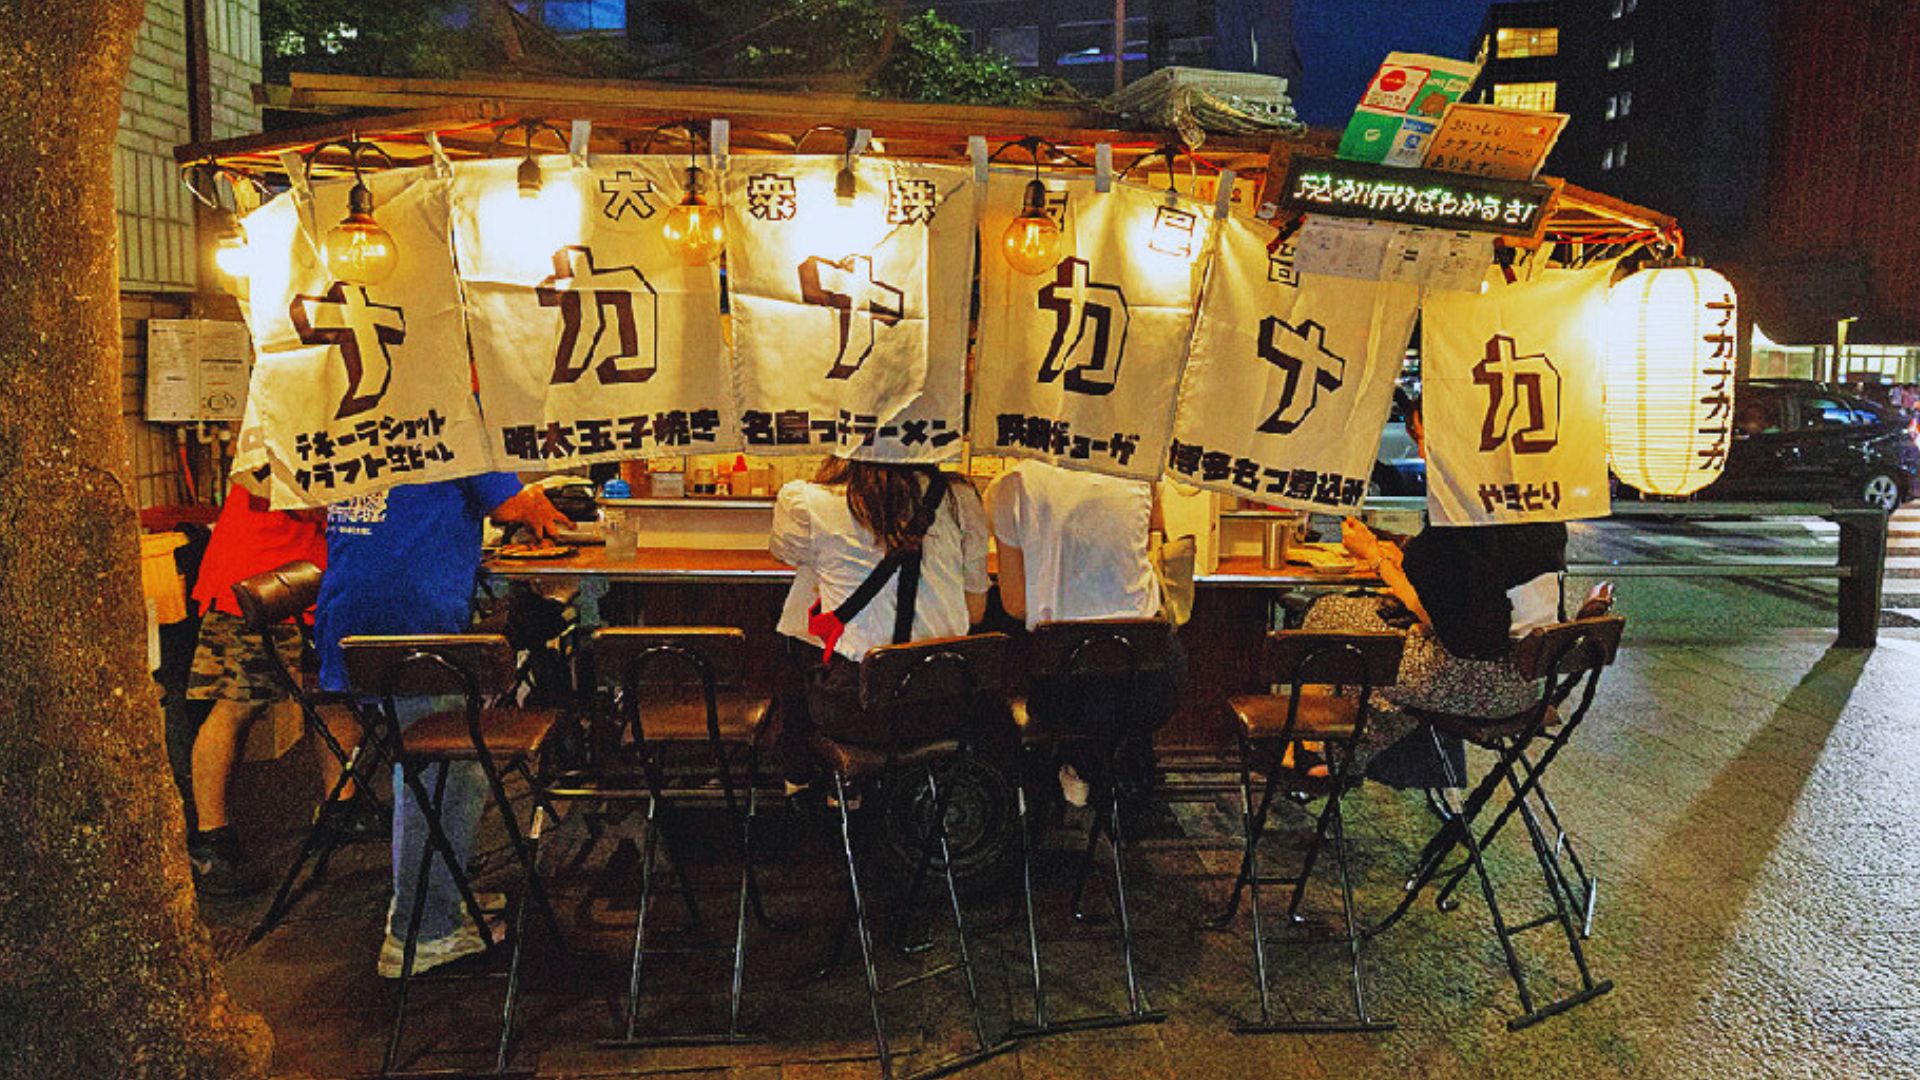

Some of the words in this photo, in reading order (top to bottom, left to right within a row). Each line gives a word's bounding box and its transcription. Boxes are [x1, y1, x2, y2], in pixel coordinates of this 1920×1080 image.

[600, 171, 657, 221] 大
[289, 281, 407, 420] ナ
[535, 244, 658, 385] カ
[797, 253, 905, 379] ナ
[1037, 255, 1131, 396] カ
[1257, 314, 1346, 436] ナ
[1472, 333, 1563, 455] カ
[1697, 293, 1736, 471] ナカナカナカ
[295, 408, 446, 461] テキーラショット
[501, 408, 721, 460] 明太玉子焼き
[295, 441, 455, 492] クラフト生ビール
[1477, 480, 1561, 515] やきとり
